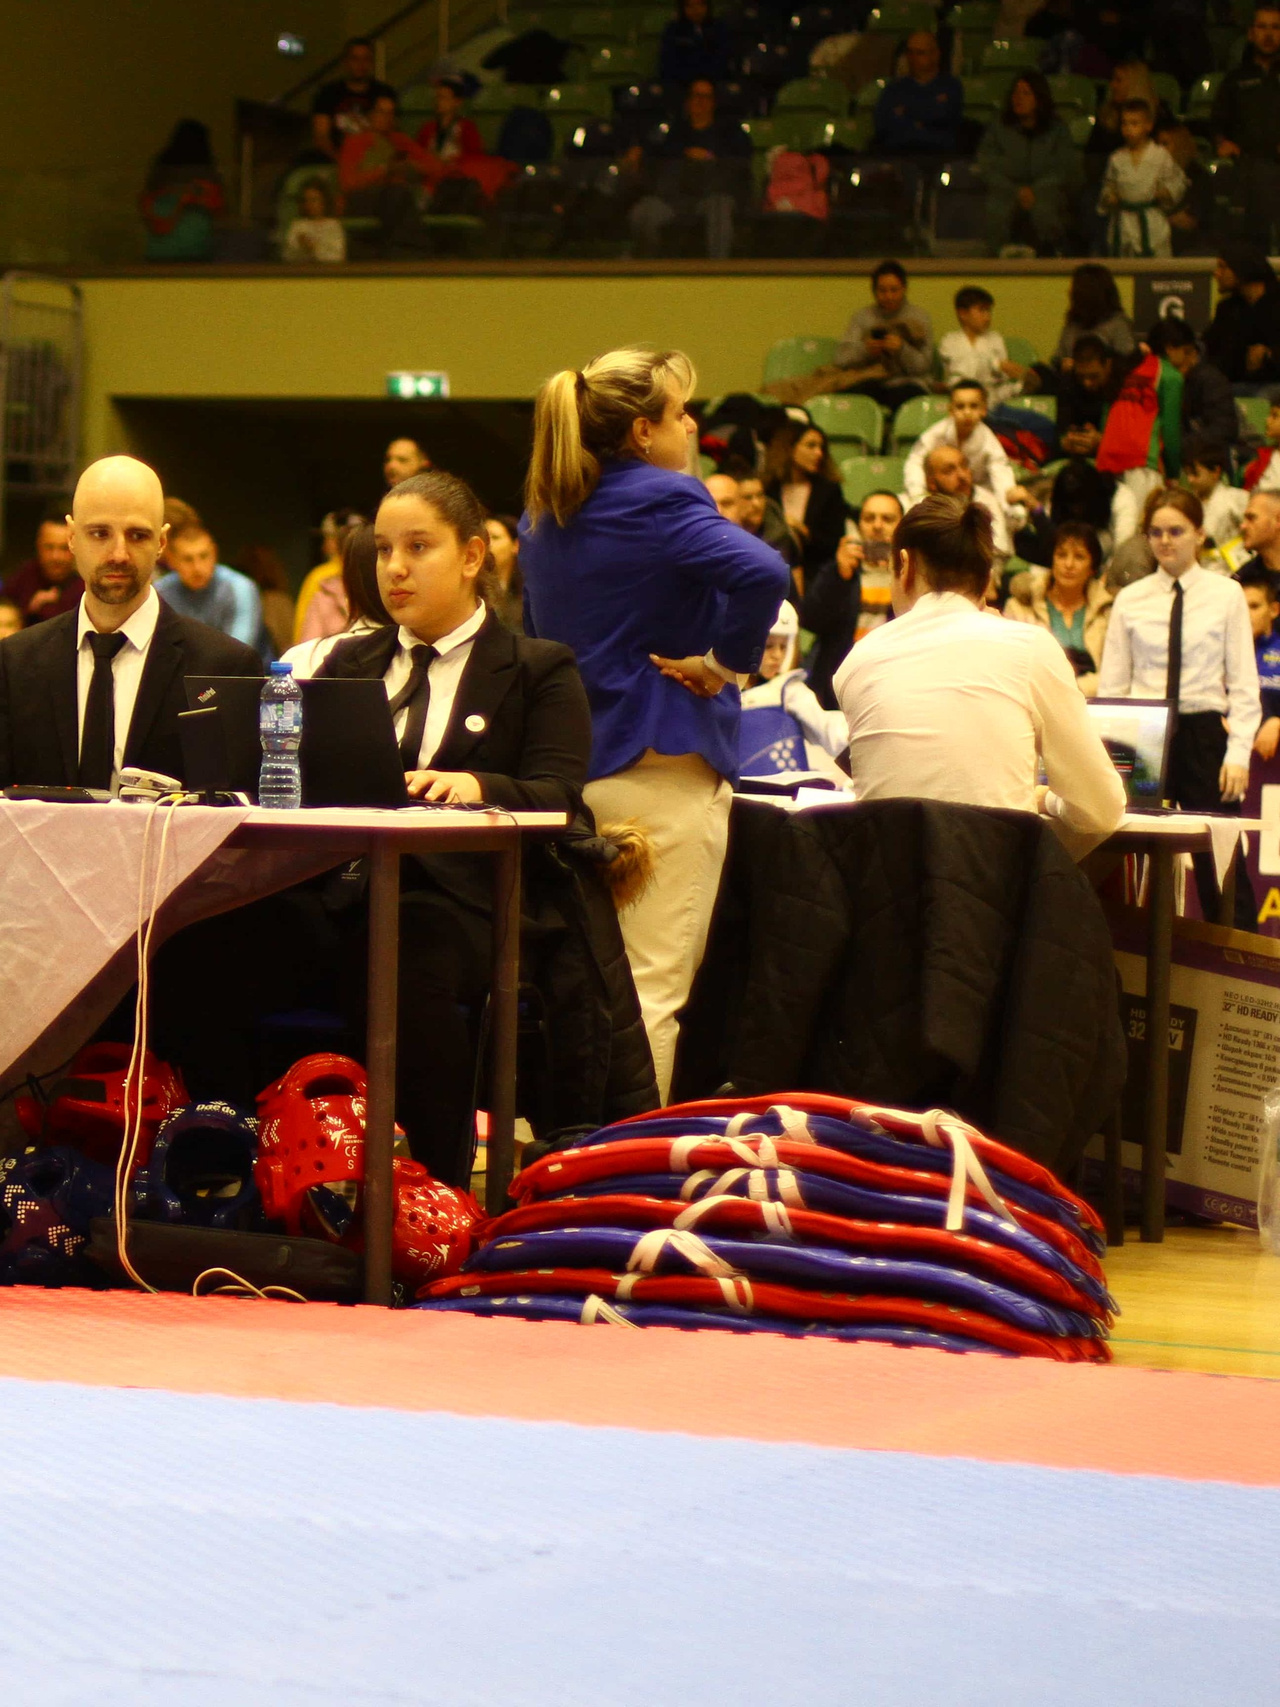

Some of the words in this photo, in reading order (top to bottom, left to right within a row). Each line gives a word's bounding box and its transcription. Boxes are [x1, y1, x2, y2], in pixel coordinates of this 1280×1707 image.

[1237, 1004, 1249, 1016] HD
[1250, 1008, 1278, 1022] READY
[348, 1159, 354, 1169] S
